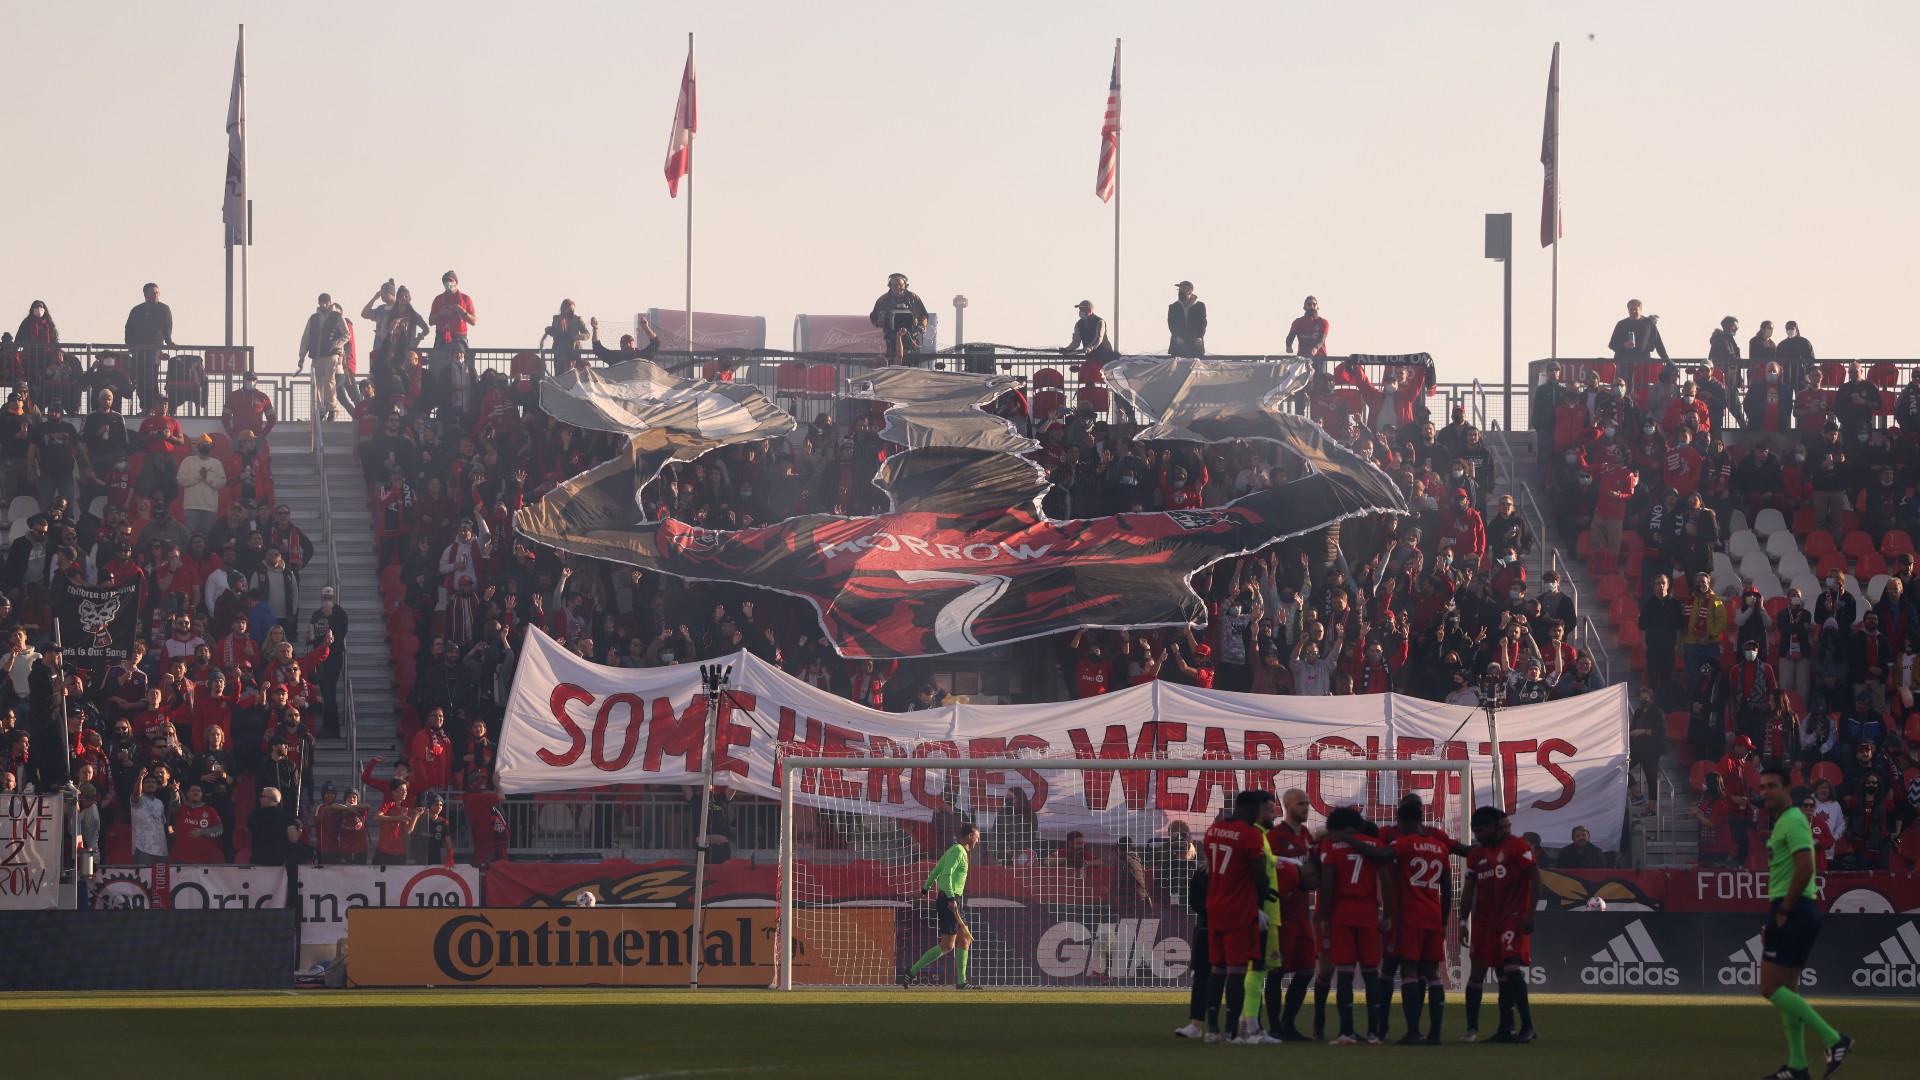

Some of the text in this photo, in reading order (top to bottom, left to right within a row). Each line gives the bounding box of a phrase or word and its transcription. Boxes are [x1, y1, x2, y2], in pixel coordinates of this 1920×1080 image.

[826, 331, 885, 346] Budweise
[210, 353, 236, 371] 114
[1357, 353, 1382, 364] ALL
[1410, 353, 1428, 364] ON
[1562, 364, 1586, 381] 116
[1649, 504, 1663, 530] ONE
[818, 532, 1054, 561] MORROW
[894, 569, 1013, 654] 7
[105, 647, 127, 659] Song
[535, 681, 1578, 822] SOME HEROES WEAR CLEATS
[0, 840, 28, 867] 2
[1209, 842, 1234, 875] 17
[1413, 842, 1443, 854] LARYEA
[1346, 853, 1364, 884] 7
[1410, 855, 1443, 890] 22
[1697, 872, 1825, 901] FORER
[433, 914, 756, 981] Continental
[1580, 961, 1680, 986] adidas
[1717, 961, 1818, 986] adis
[1851, 962, 1920, 987] adid
